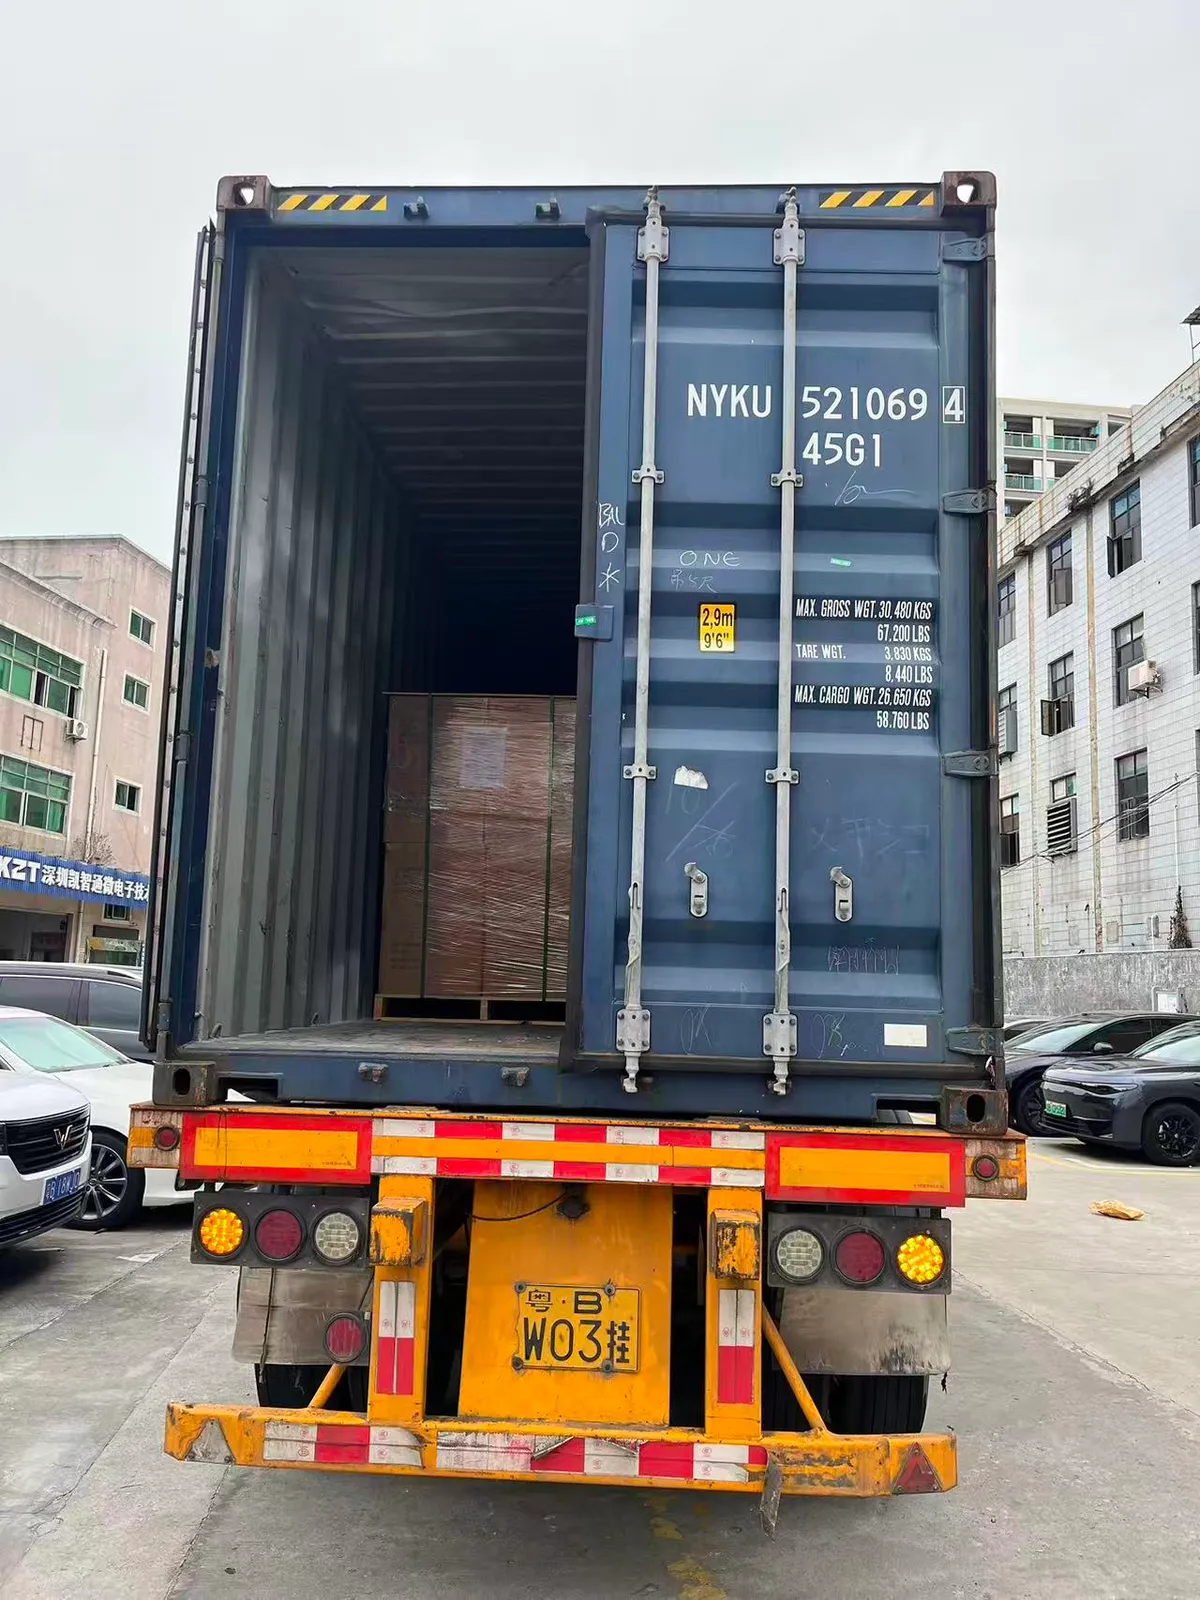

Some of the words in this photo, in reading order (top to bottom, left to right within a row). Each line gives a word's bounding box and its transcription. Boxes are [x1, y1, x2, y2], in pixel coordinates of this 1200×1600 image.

[687, 383, 772, 418] NYKU
[802, 386, 928, 421] 521069
[944, 388, 964, 421] 4
[802, 432, 881, 467] 45G1
[680, 550, 740, 566] ONE
[702, 607, 733, 629] 2,9m
[796, 599, 817, 617] MAX.
[820, 600, 851, 618] GROSS
[854, 600, 877, 618] WGT.
[878, 600, 912, 619] 30,480
[913, 602, 932, 620] KGS
[704, 632, 729, 648] 9'6"
[912, 625, 930, 642] LBS
[796, 644, 818, 658] TARE
[821, 645, 846, 659] WGT.
[912, 647, 932, 661] KGS
[885, 664, 912, 683] 8,440
[914, 665, 933, 683] LBS
[794, 684, 817, 703] MAX.
[819, 685, 850, 704] CARGO
[853, 687, 877, 705] WGT.
[877, 687, 912, 706] 26,650
[912, 689, 932, 707] KGS
[911, 712, 930, 730] LBS
[0, 856, 40, 883] KZT
[523, 1317, 629, 1368] W03挂
